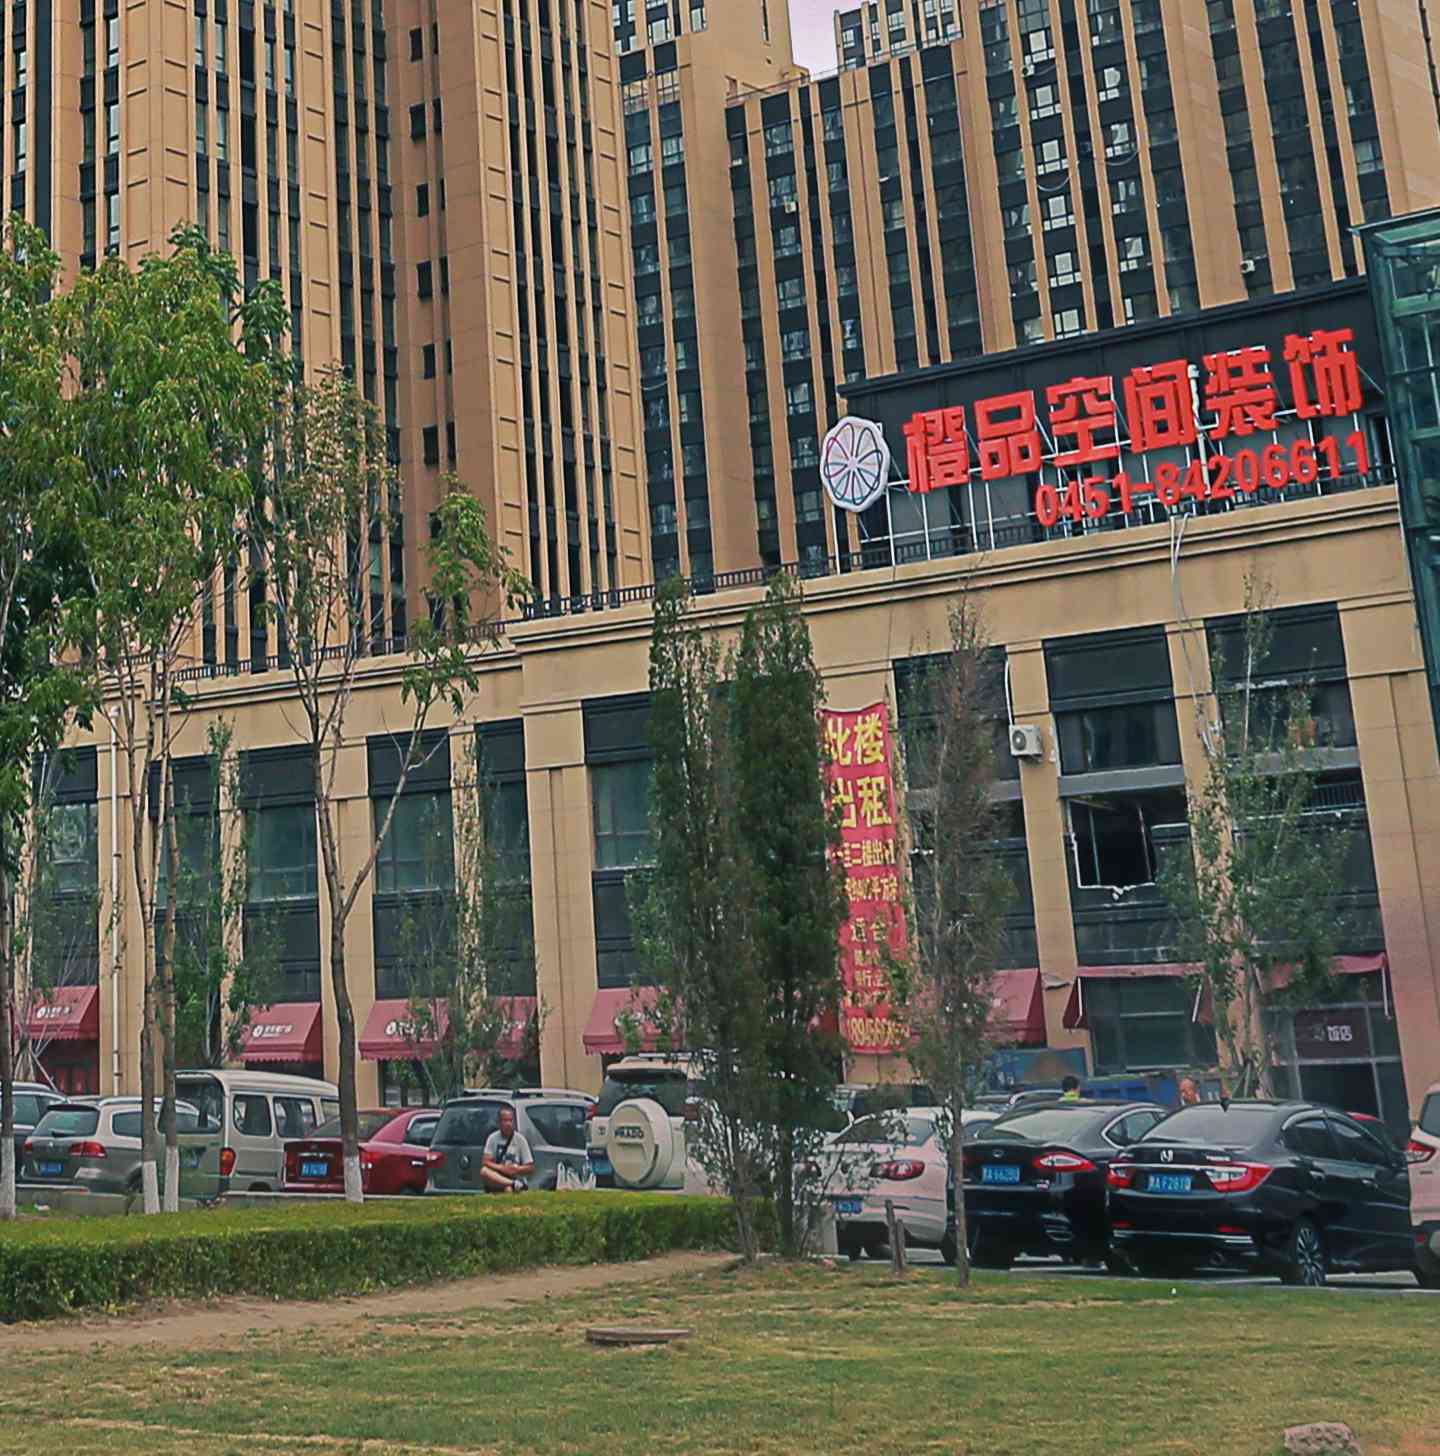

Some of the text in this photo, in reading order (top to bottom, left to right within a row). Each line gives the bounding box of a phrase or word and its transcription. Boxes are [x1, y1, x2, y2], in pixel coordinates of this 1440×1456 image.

[902, 327, 1364, 494] 橙品空间装饰
[1034, 430, 1370, 528] 0451-84206611
